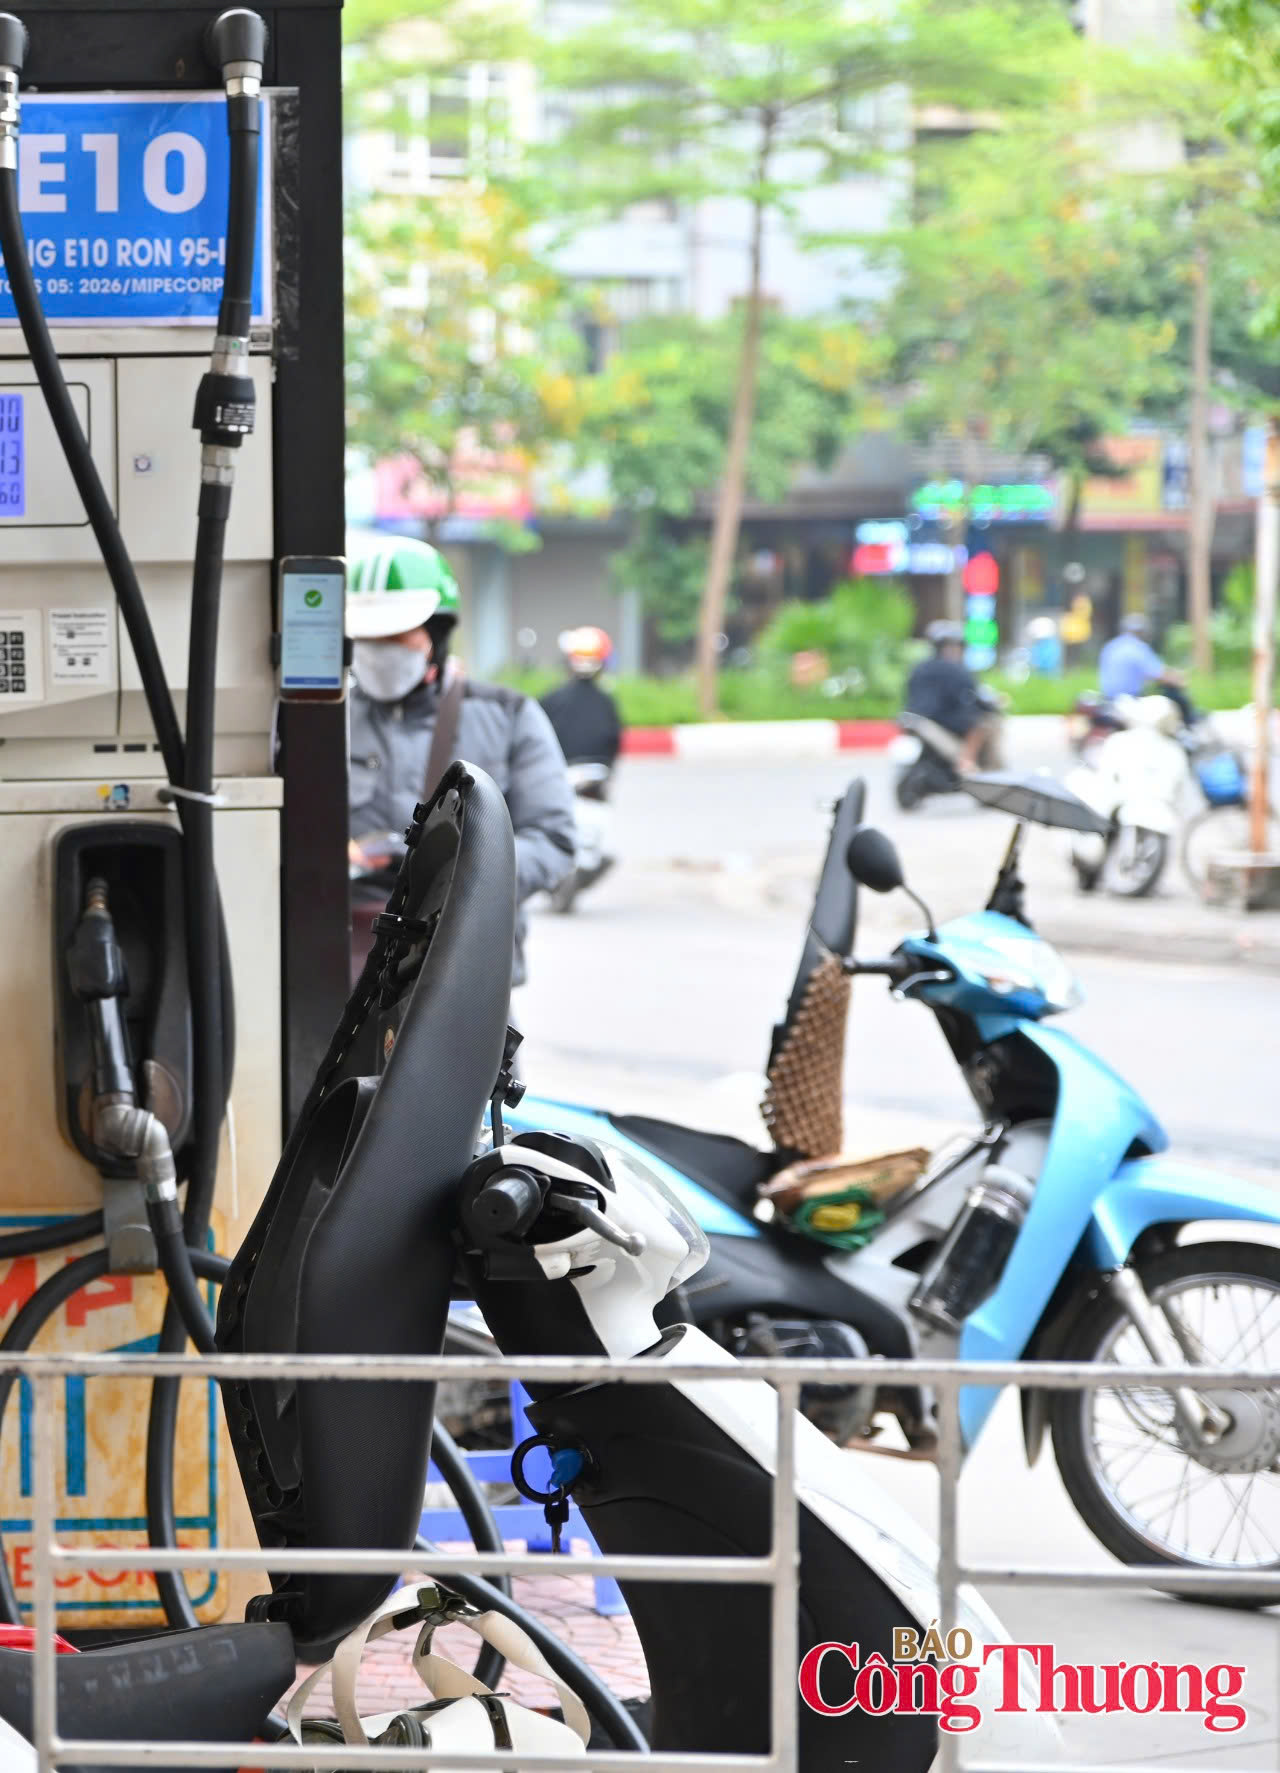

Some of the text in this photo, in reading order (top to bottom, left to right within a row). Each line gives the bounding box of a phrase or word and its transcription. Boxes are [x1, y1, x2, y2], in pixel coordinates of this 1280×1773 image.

[18, 131, 207, 213] E10
[65, 238, 109, 267] E10
[117, 238, 172, 267] RON
[47, 278, 73, 294] 05:
[79, 276, 224, 295] 2026/MIPECORP
